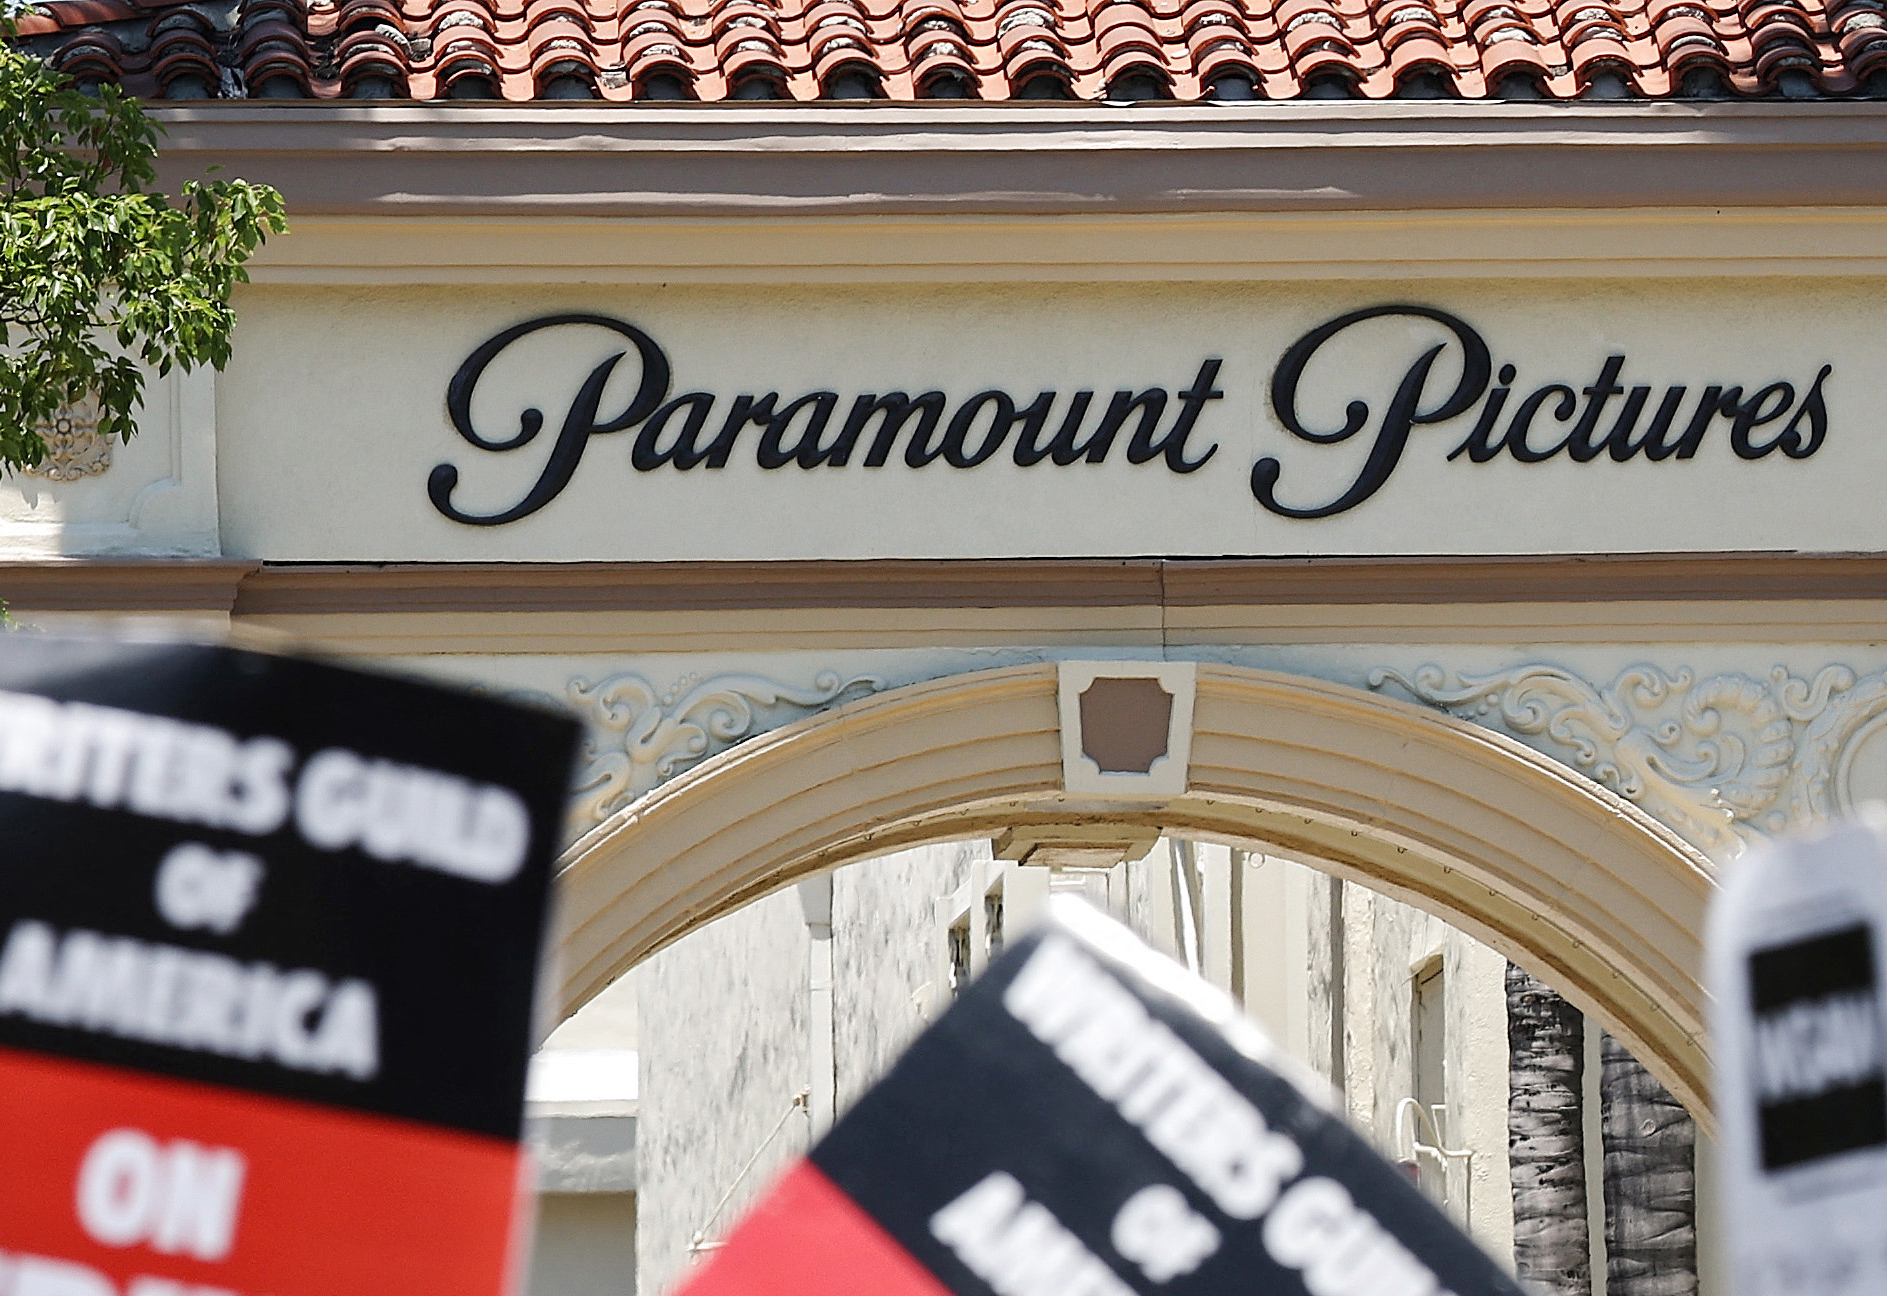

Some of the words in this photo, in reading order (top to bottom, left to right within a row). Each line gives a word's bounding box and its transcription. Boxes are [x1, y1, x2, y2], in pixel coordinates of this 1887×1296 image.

[427, 312, 1225, 525] Paramount
[1250, 303, 1832, 520] Pictures
[297, 751, 527, 881] GUILD
[158, 845, 262, 929] OF
[1007, 939, 1300, 1215] WRITERS
[78, 1132, 243, 1258] ON
[1114, 1186, 1218, 1279] OF
